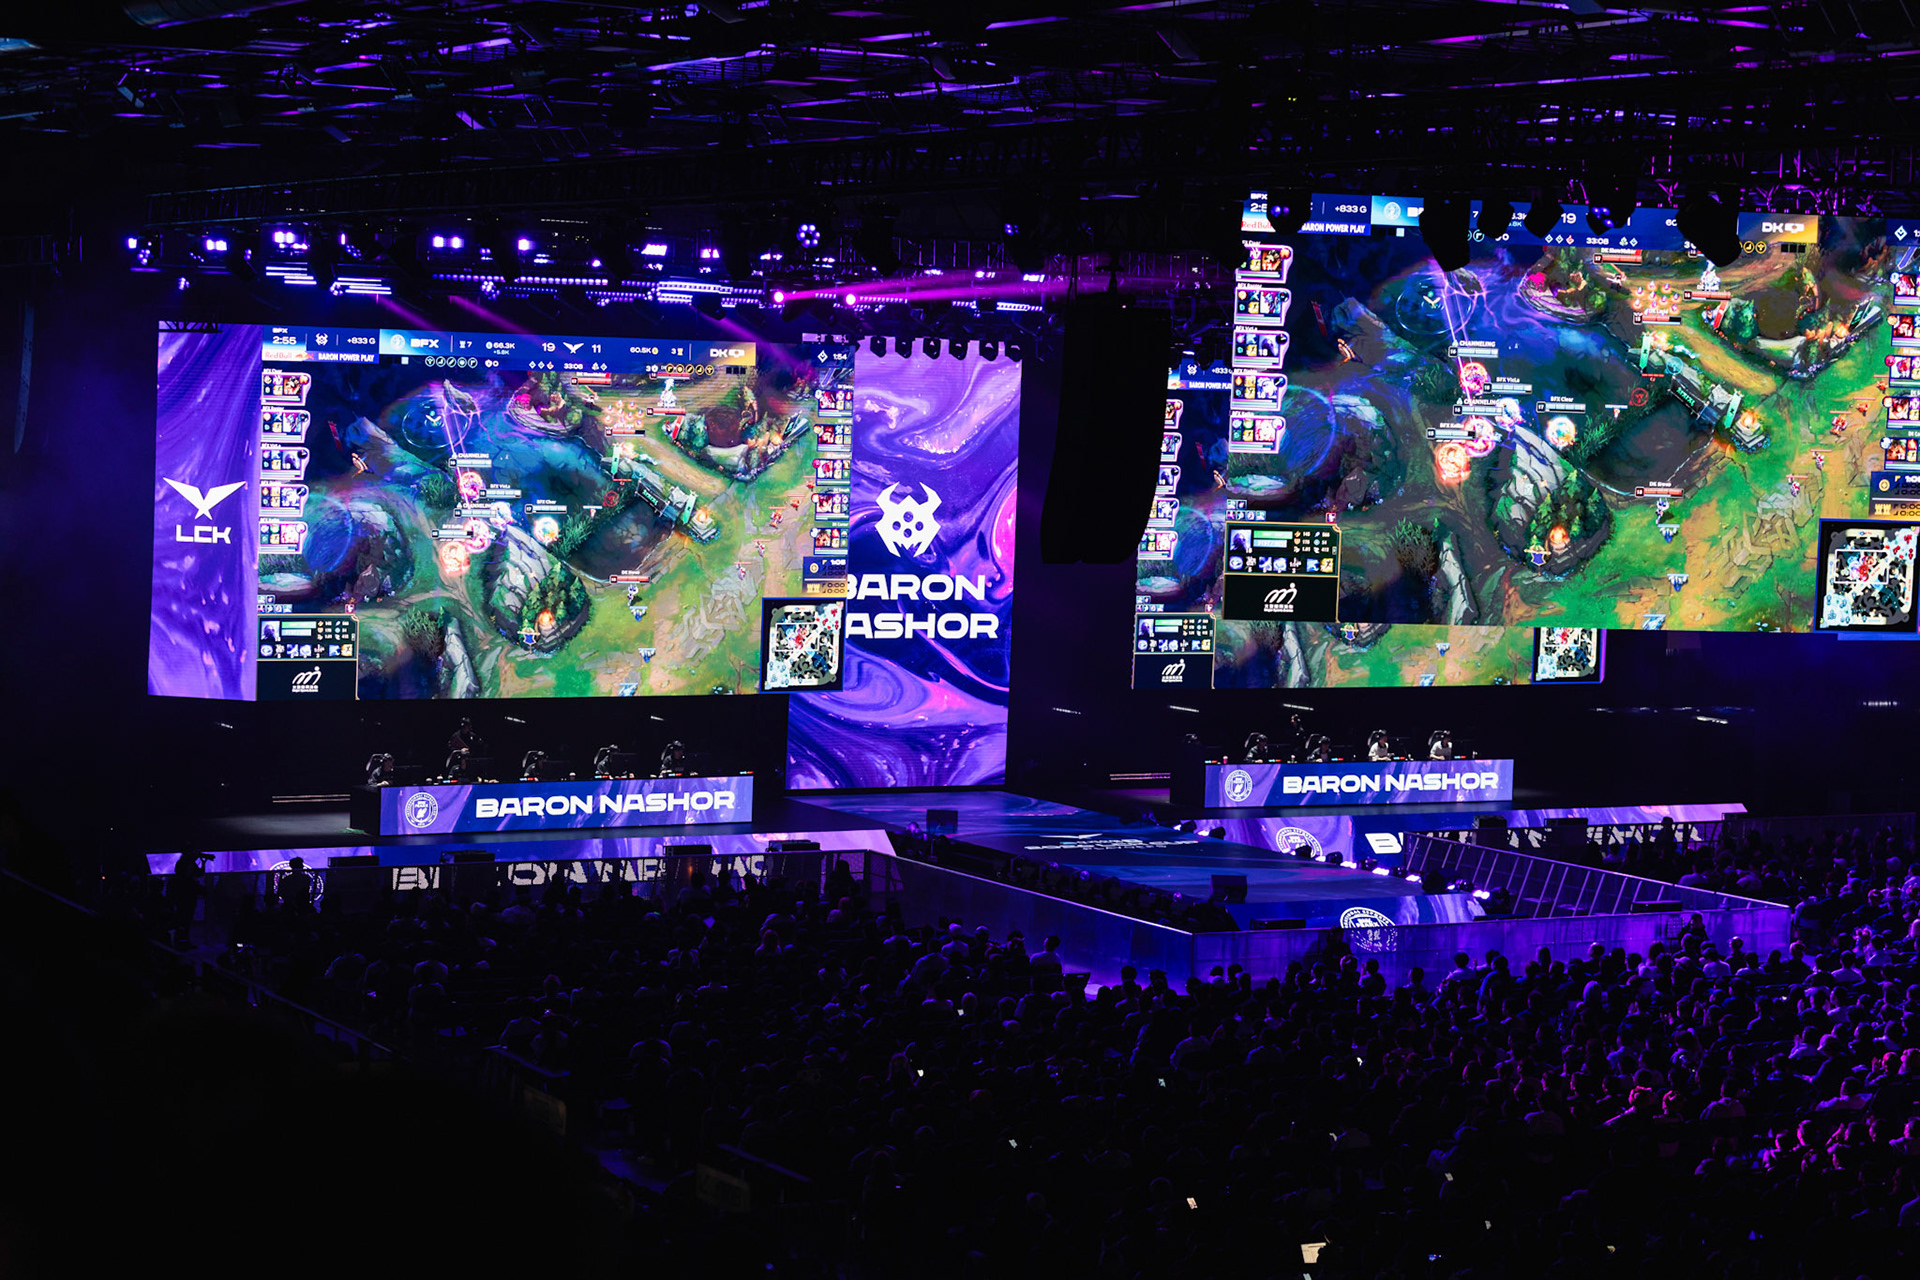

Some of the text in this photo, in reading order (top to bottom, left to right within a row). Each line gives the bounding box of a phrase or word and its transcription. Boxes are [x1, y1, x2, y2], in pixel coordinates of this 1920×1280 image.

[1250, 203, 1268, 212] 2:5
[1334, 204, 1367, 213] +833 G
[1560, 212, 1577, 224] 19
[1326, 223, 1349, 233] POWER
[1350, 224, 1366, 234] PLAY
[1762, 222, 1783, 233] DK
[272, 336, 297, 345] 2:55
[347, 337, 368, 345] +833
[542, 342, 556, 352] 19
[592, 344, 602, 353] 11
[318, 352, 375, 362] BARON POWER PLAY
[710, 349, 728, 358] DK
[176, 524, 232, 544] LCK
[845, 612, 1000, 638] ASHOR
[1282, 772, 1500, 794] BARON NASHOR
[475, 790, 736, 818] BARON NASHOR
